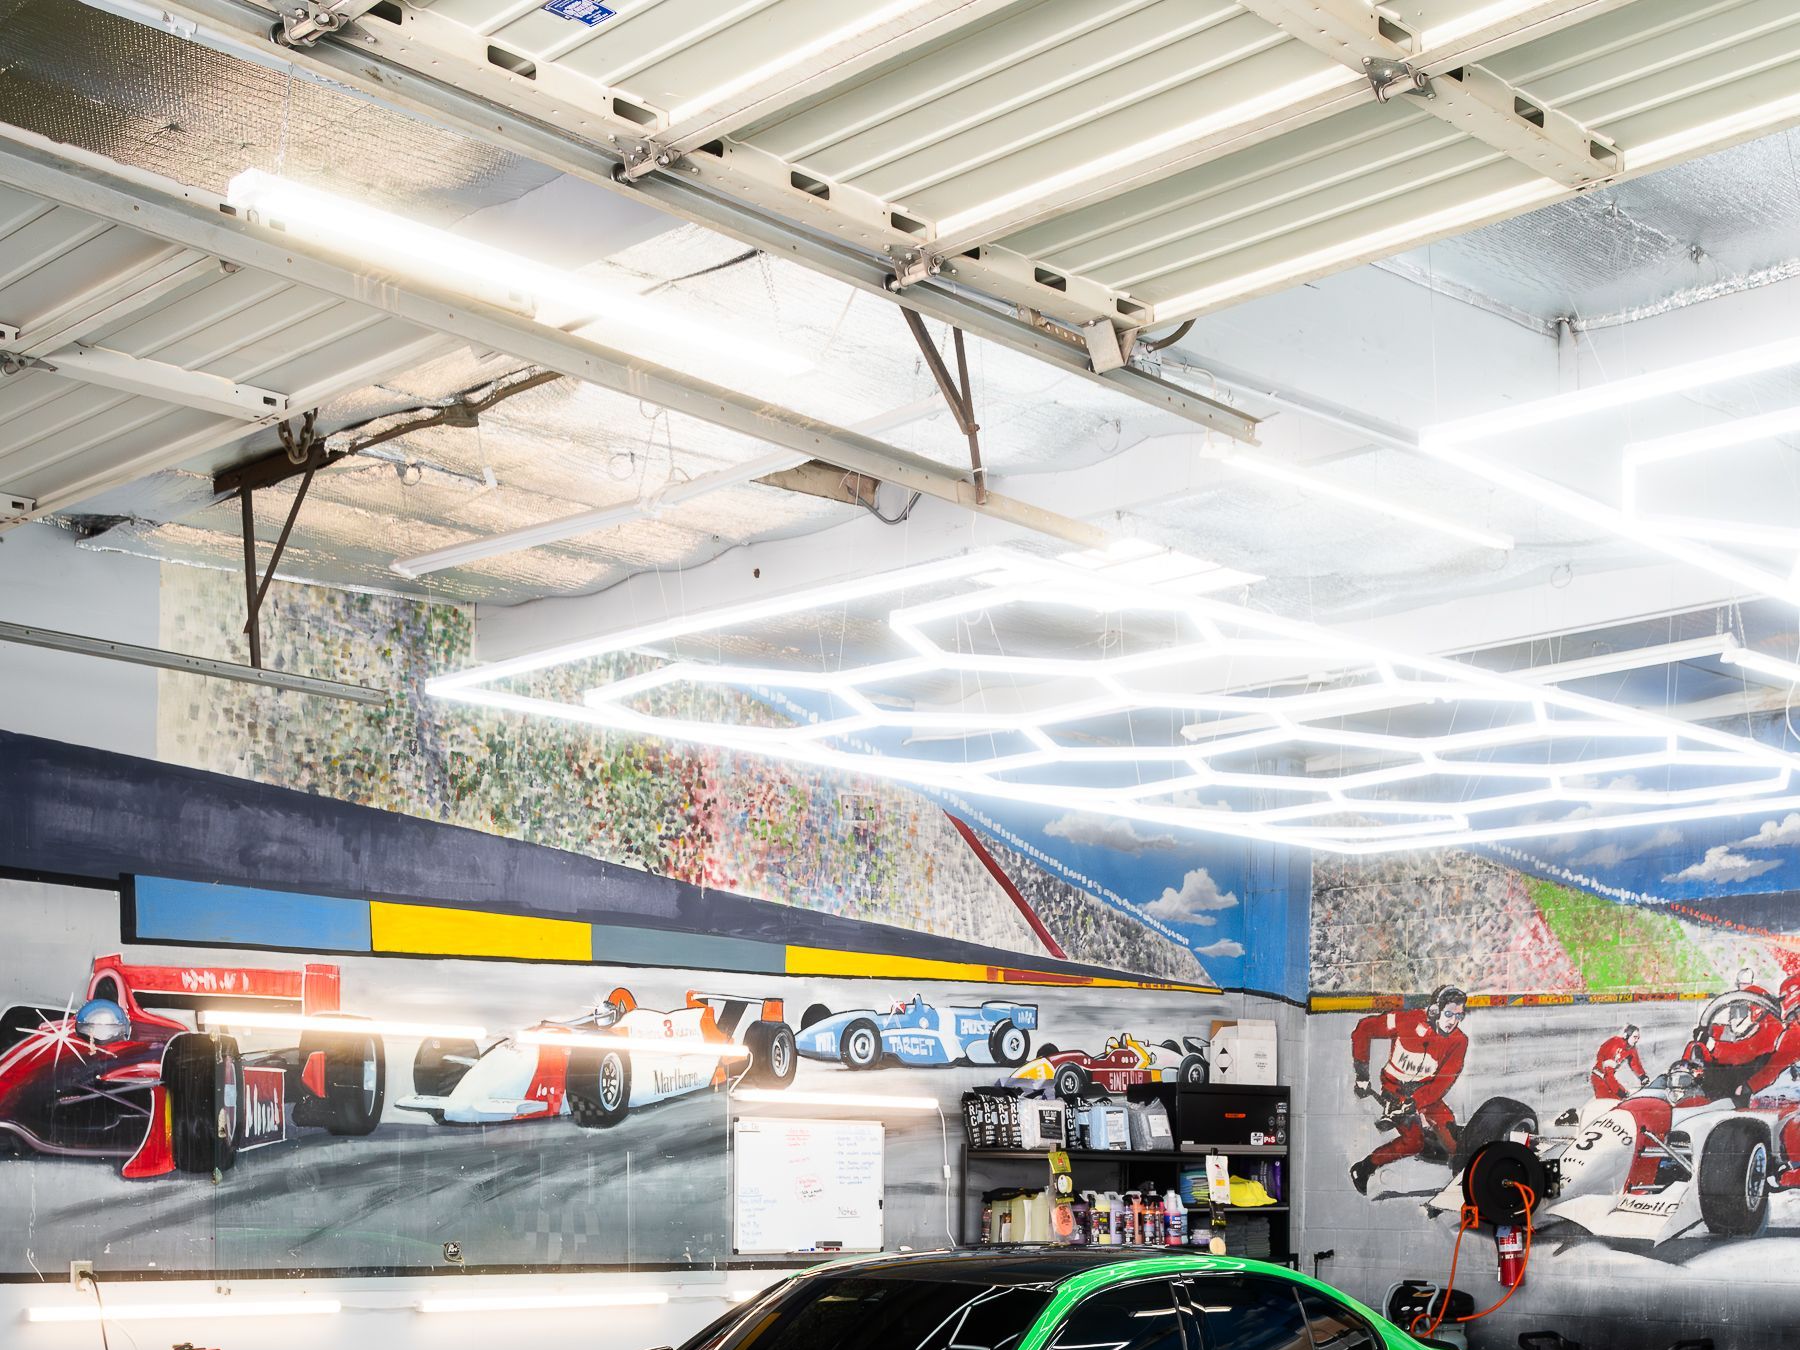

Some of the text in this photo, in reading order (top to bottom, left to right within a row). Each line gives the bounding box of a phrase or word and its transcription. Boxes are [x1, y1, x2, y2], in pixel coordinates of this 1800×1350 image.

[663, 1019, 674, 1038] 3
[888, 1035, 936, 1057] TARGET
[1575, 1131, 1603, 1151] 3
